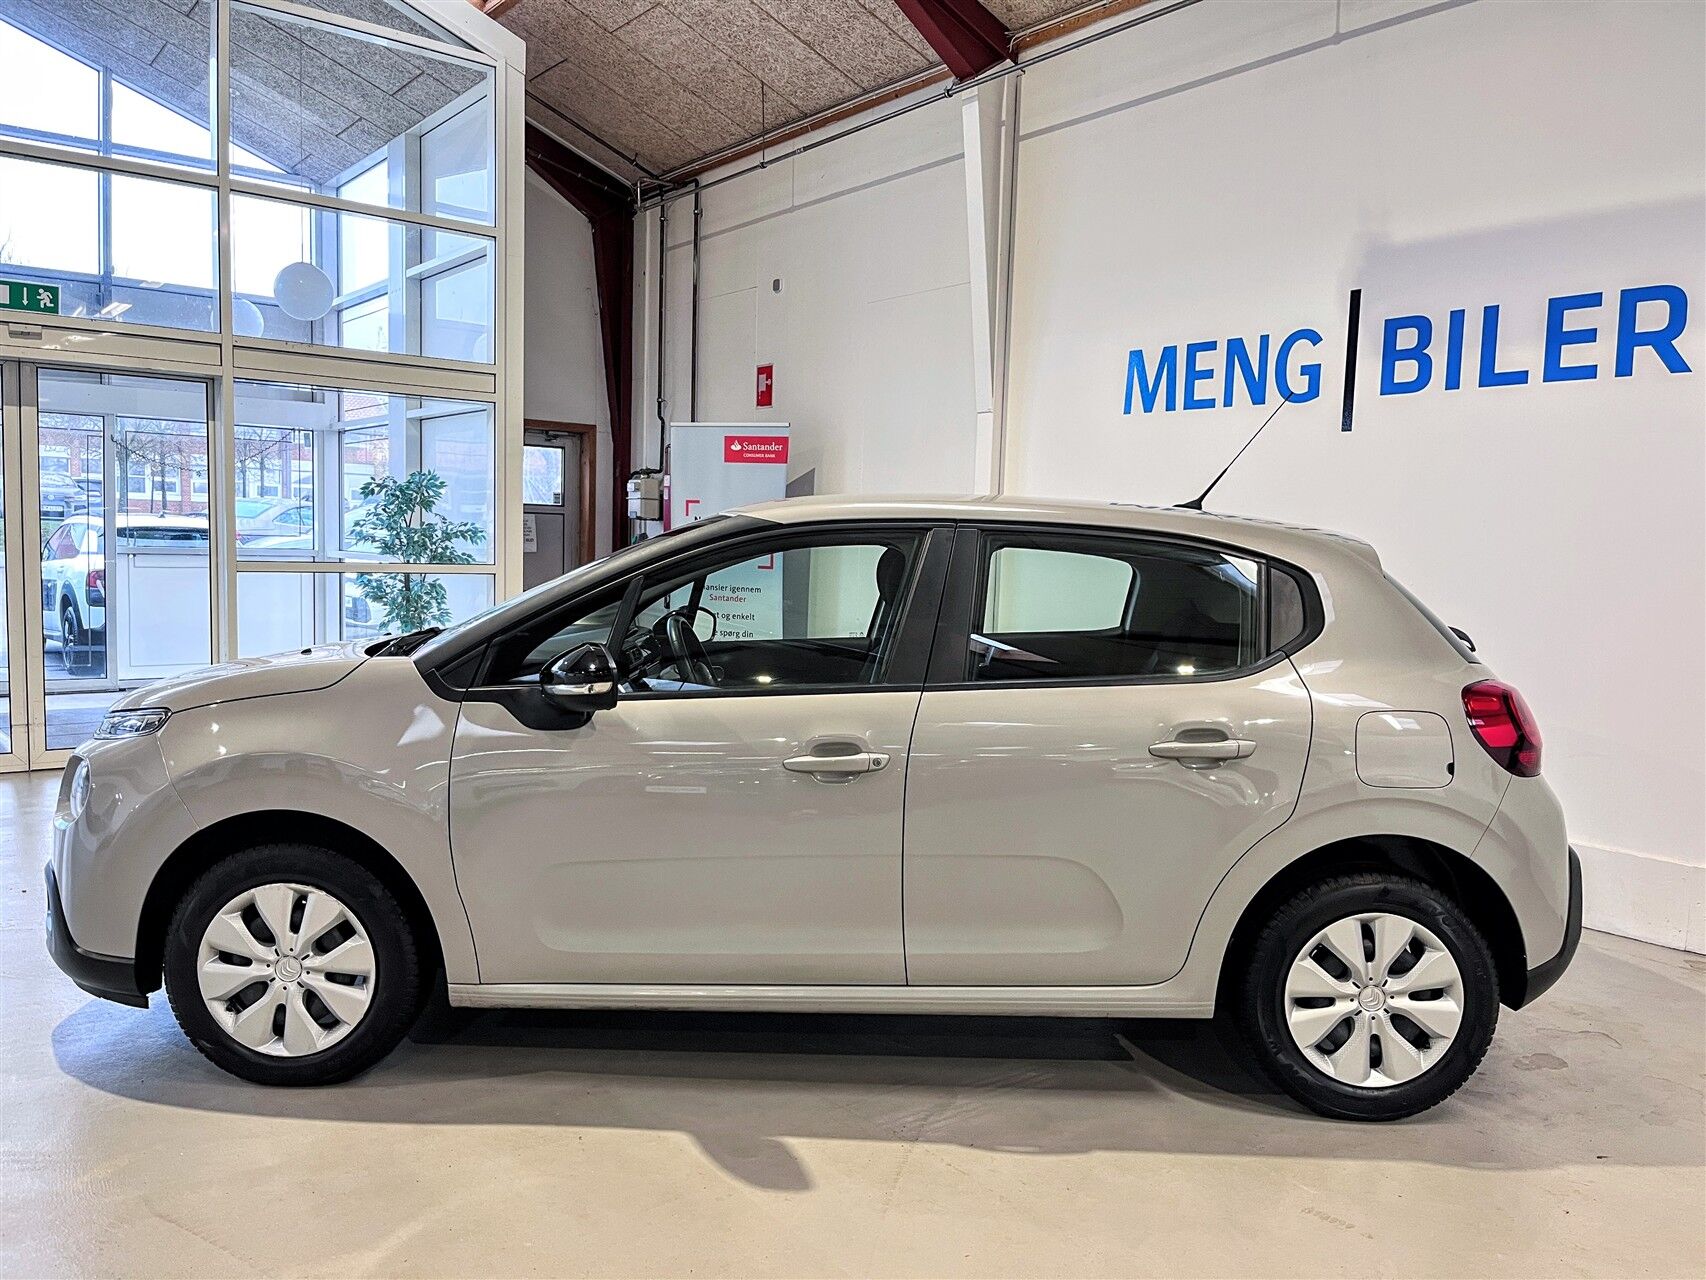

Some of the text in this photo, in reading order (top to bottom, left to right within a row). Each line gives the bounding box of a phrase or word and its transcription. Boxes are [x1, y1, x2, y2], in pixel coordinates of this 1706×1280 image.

[1123, 284, 1692, 415] MENG BILER
[742, 441, 783, 451] Santander
[729, 584, 762, 594] igennem
[709, 594, 746, 602] Santander
[721, 613, 731, 621] og
[732, 612, 755, 621] enkelt
[741, 630, 754, 638] din
